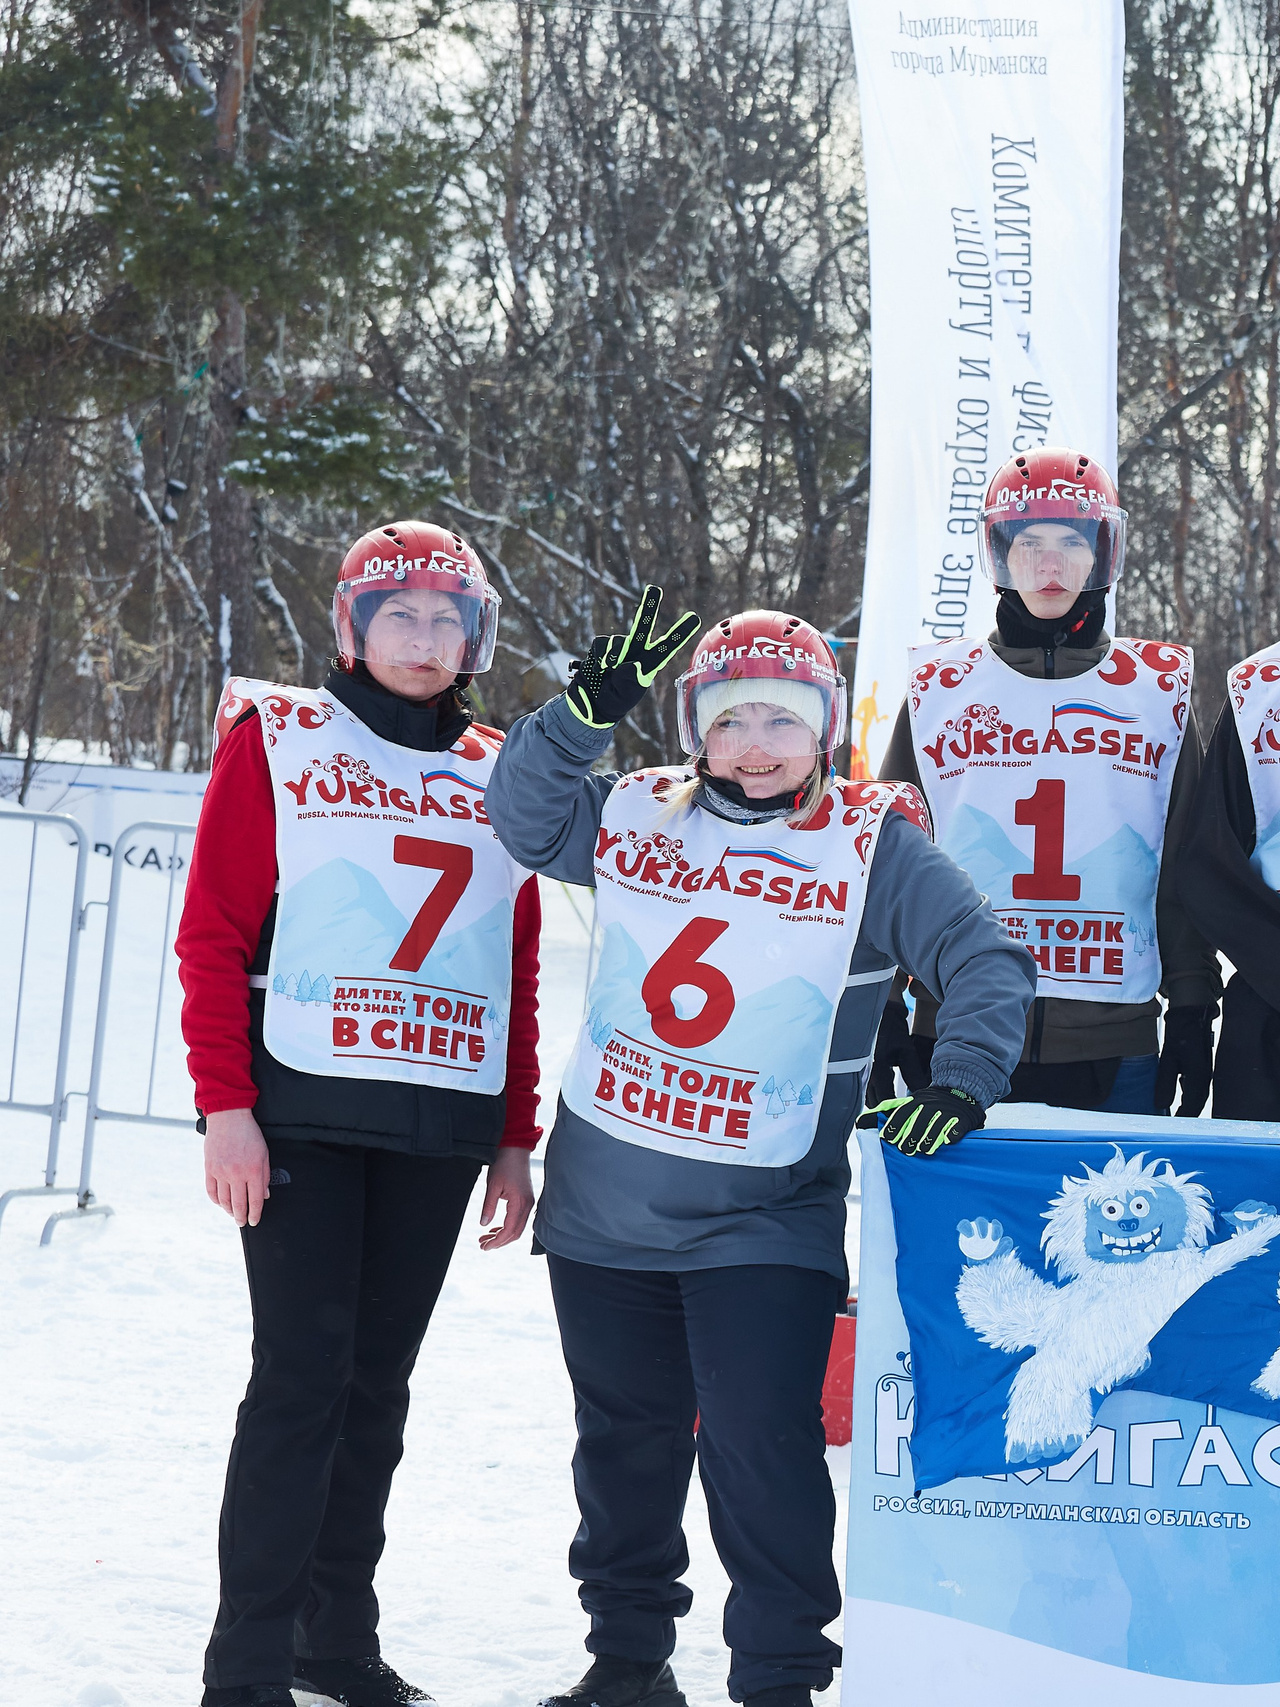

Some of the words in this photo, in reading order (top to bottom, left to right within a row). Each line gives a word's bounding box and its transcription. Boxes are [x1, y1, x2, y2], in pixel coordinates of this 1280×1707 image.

[949, 45, 1048, 77] Мурманска
[991, 133, 1037, 314] Комитет
[958, 356, 991, 381] и
[945, 398, 990, 535] охране
[922, 554, 974, 639] здор
[966, 760, 1000, 768] RMANSK
[1001, 760, 1032, 768] REGION
[1112, 763, 1150, 779] СНЕЖНЫЙ
[283, 765, 492, 826] YUKIGASS
[297, 810, 329, 820] RUSSIA,
[331, 810, 380, 820] MURMANSK
[382, 814, 415, 824] REGION
[1011, 778, 1082, 902] 1
[594, 866, 615, 883] USSIA,
[617, 879, 662, 899] MURMANSK
[662, 893, 692, 905] REGION
[388, 834, 474, 973] 7
[778, 913, 823, 923] СНЕЖНЫЙ
[825, 917, 845, 926] БОЙ
[1035, 919, 1125, 943] ТОЛК
[1026, 945, 1123, 976] НЕГЕ
[333, 987, 369, 1000] ДЛЯ
[372, 988, 406, 1003] ТЕХ,
[641, 916, 736, 1049] 6
[333, 1002, 360, 1012] КТО
[363, 1003, 406, 1015] ЗНАЕТ
[412, 993, 486, 1029] ТОЛК
[332, 1017, 360, 1047] В
[371, 1018, 485, 1063] СНЕГЕ
[605, 1039, 628, 1058] ДЛЯ
[628, 1049, 653, 1069] ТЕХ,
[602, 1052, 620, 1068] КТО
[620, 1061, 652, 1081] ЗНАЕТ
[660, 1061, 756, 1105] ТОЛК
[595, 1067, 616, 1102] В
[622, 1081, 751, 1140] СНЕГЕ
[873, 1494, 971, 1518] РОССИЯ,
[975, 1500, 1140, 1525] МУРМАНСКАЯ
[1144, 1509, 1251, 1529] ОБЛАСТЬ
